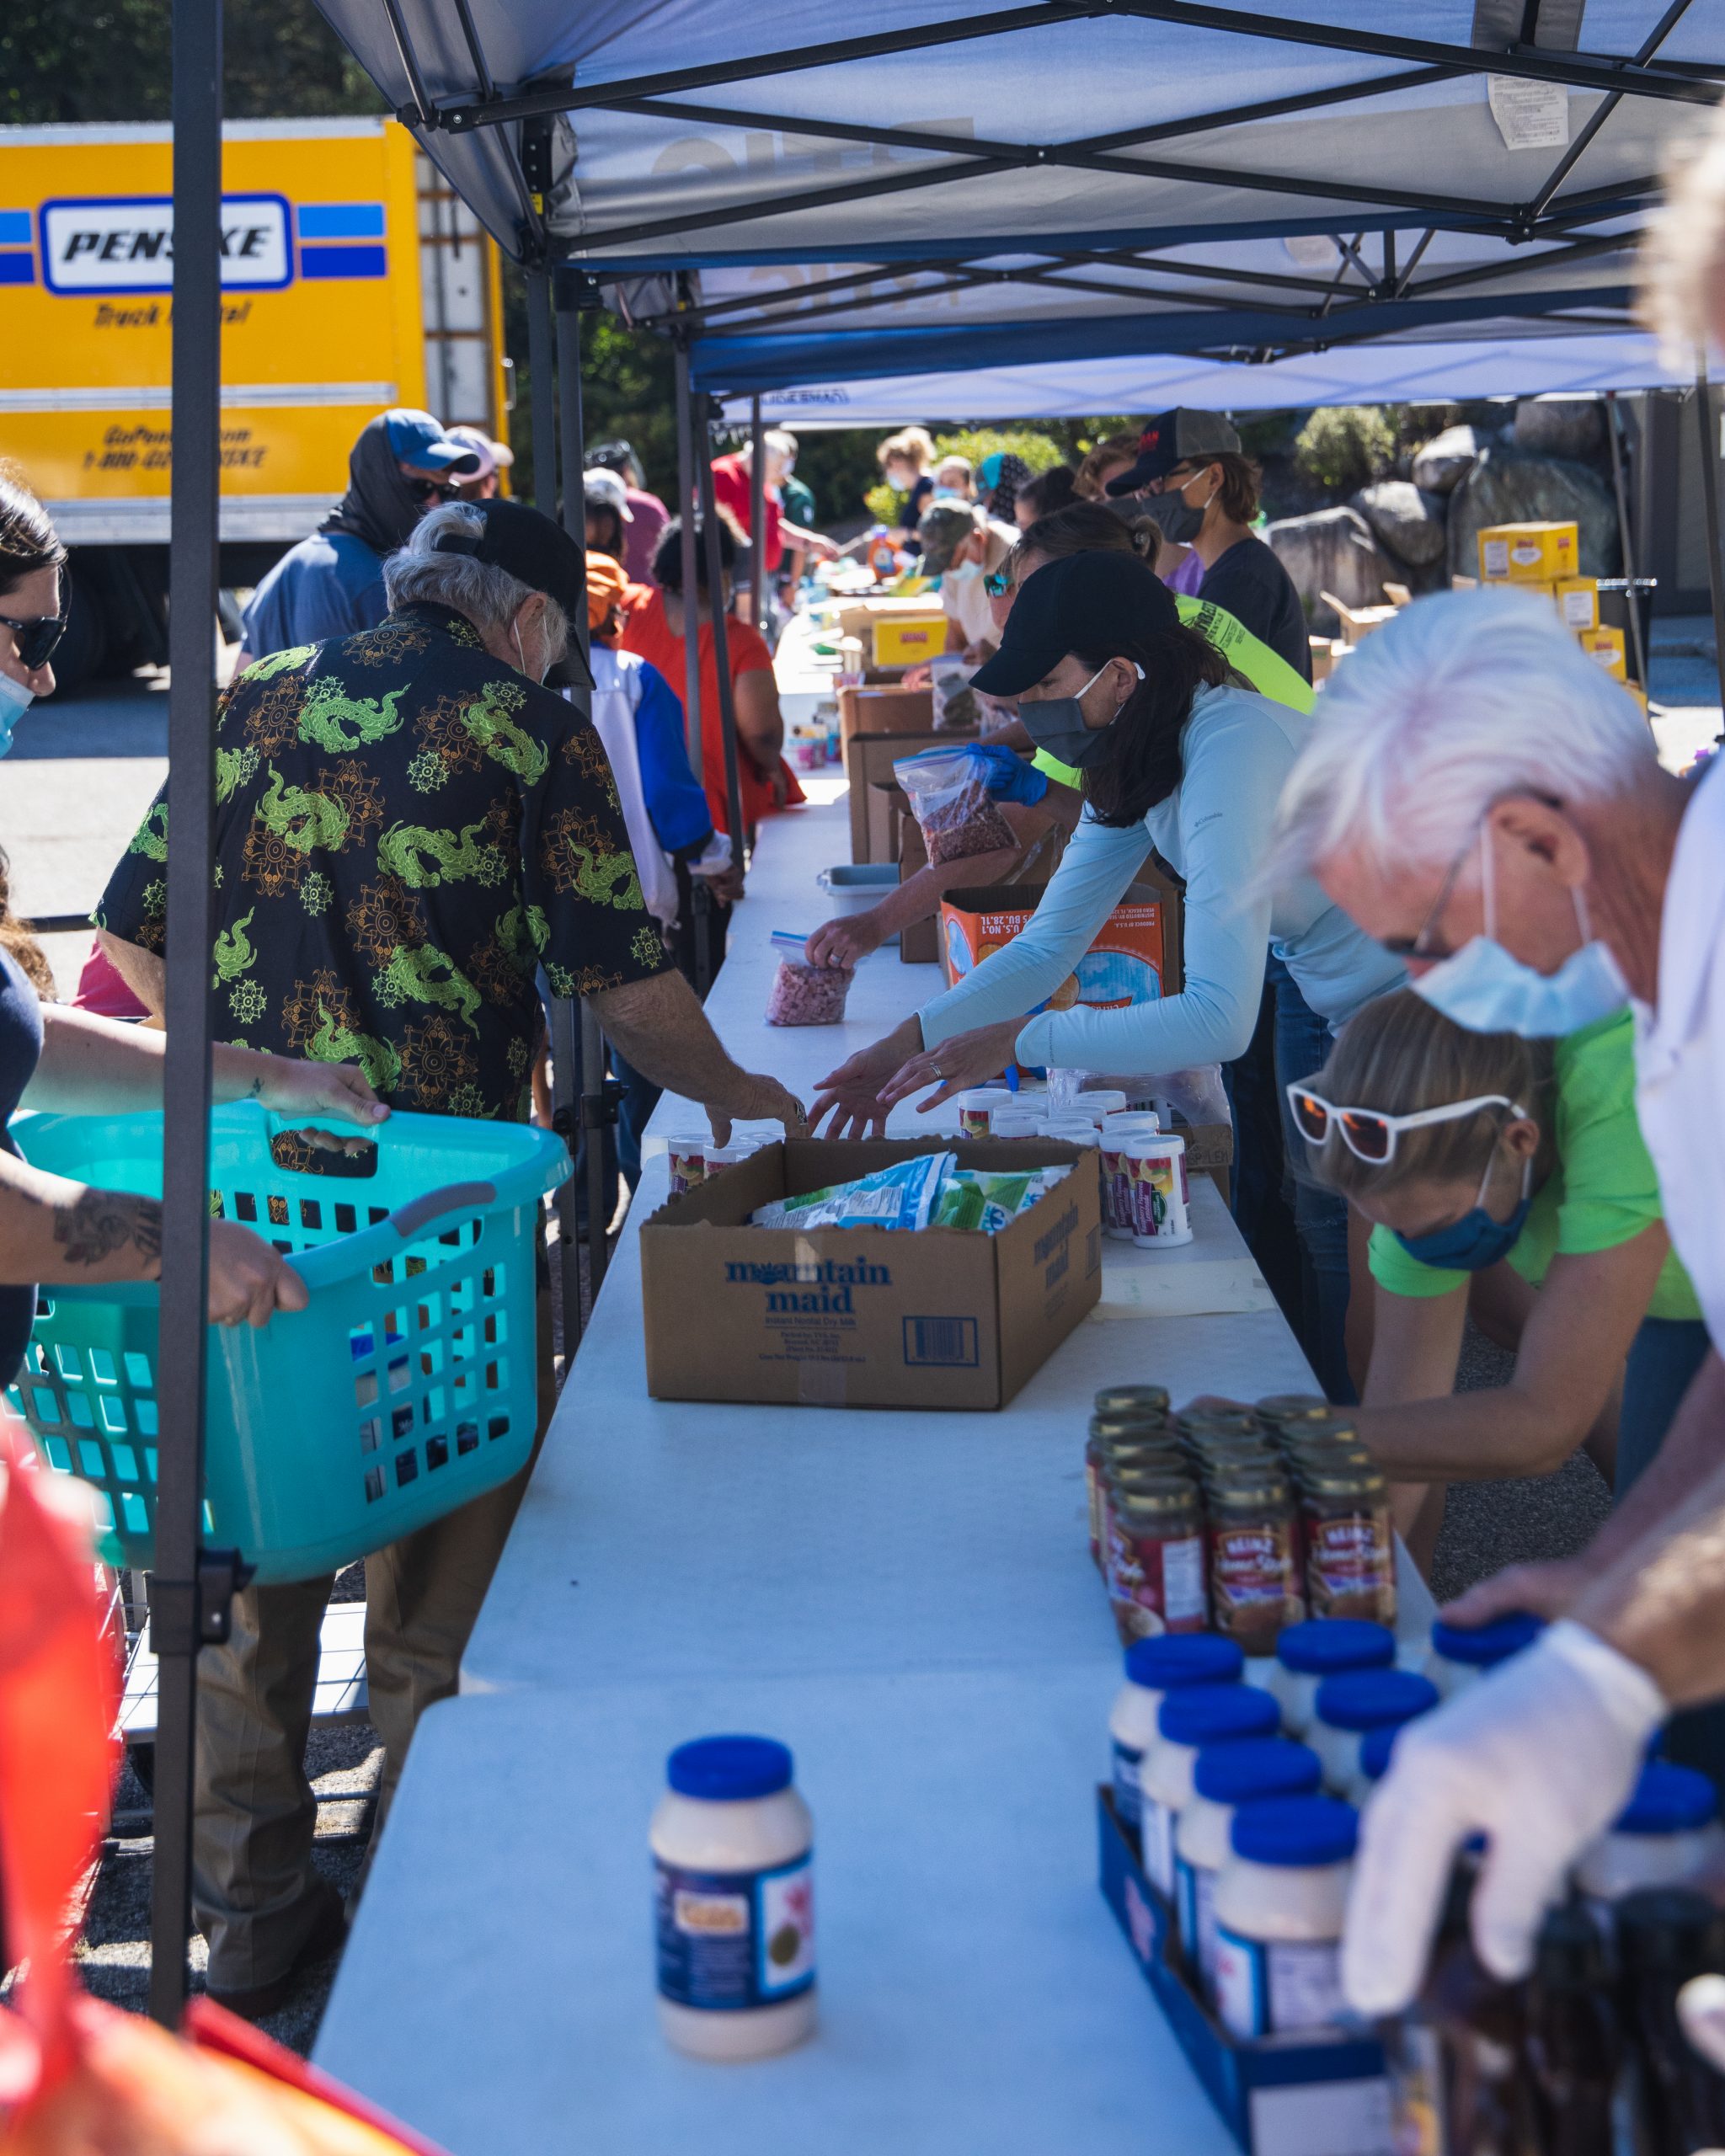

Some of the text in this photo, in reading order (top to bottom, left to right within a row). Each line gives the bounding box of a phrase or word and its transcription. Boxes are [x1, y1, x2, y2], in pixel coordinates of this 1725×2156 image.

[63, 226, 270, 263] PENKE
[94, 302, 160, 328] Truck
[980, 915, 1004, 926] 28.1L
[1002, 924, 1019, 933] U.S.
[1005, 915, 1021, 925] BU.
[1142, 1194, 1151, 1222] Lemonade
[766, 1285, 855, 1314] maid
